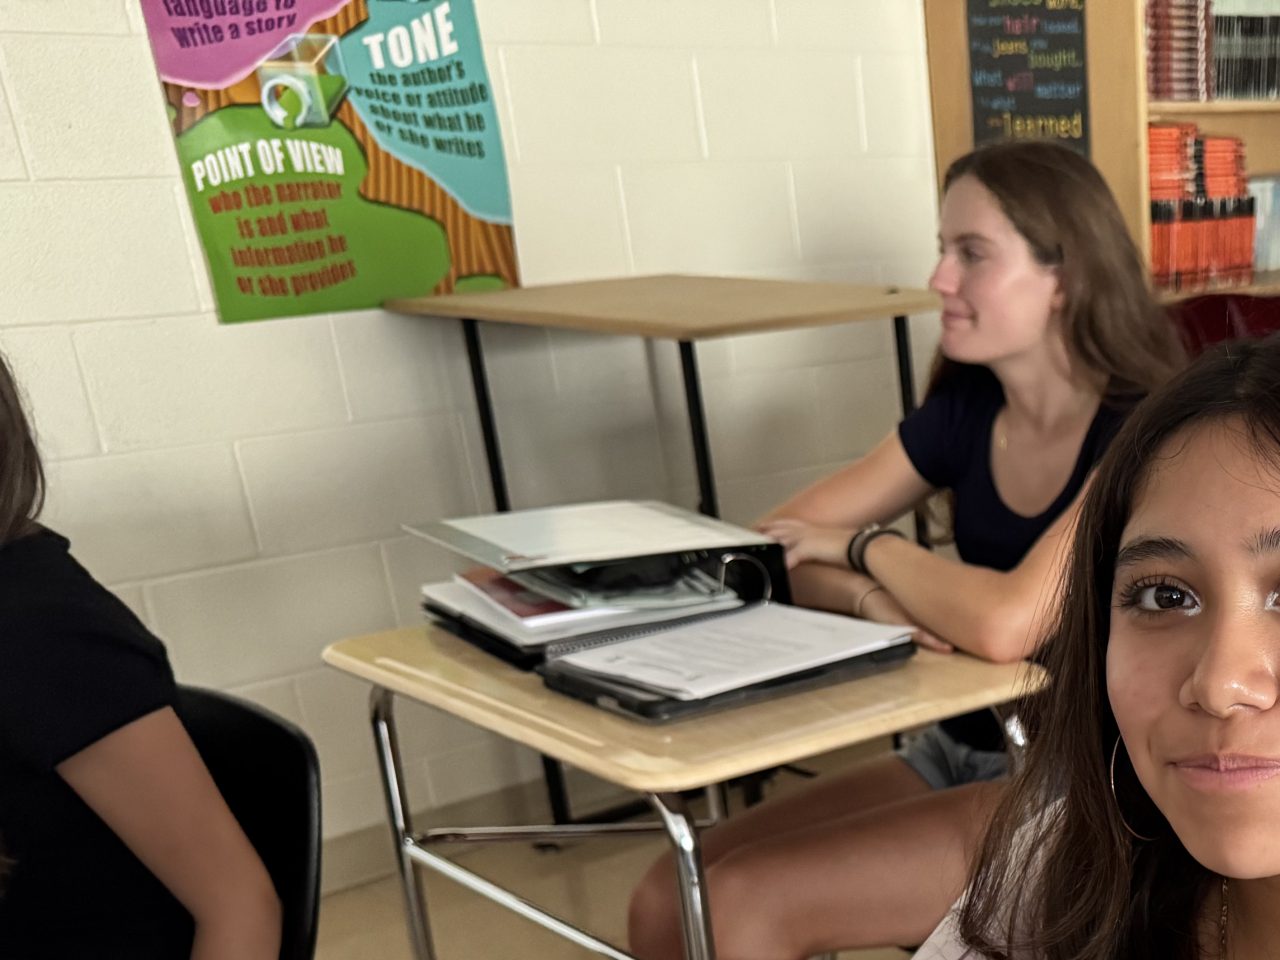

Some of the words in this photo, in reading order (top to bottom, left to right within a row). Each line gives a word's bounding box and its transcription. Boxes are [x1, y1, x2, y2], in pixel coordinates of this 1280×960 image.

[228, 23, 241, 39] a
[245, 13, 297, 36] story
[362, 1, 459, 69] TONE
[369, 71, 398, 86] the
[401, 60, 466, 86] author's
[353, 86, 401, 105] voice
[405, 92, 422, 107] or
[426, 82, 488, 108] attitude
[369, 104, 418, 126] about
[422, 113, 463, 131] what
[464, 112, 486, 132] he
[1003, 110, 1082, 139] learned
[374, 120, 393, 136] or
[398, 128, 430, 148] she
[432, 135, 486, 159] writes
[191, 142, 255, 192] POINT
[256, 138, 285, 175] OF
[285, 138, 345, 176] VIEW
[208, 190, 242, 215] who
[245, 183, 273, 208] the
[275, 181, 342, 203] narrator
[236, 216, 254, 239] is
[256, 210, 288, 237] and
[290, 209, 330, 233] what
[230, 239, 325, 267] information
[326, 234, 349, 253] he
[258, 274, 289, 297] she
[290, 259, 357, 296] provides
